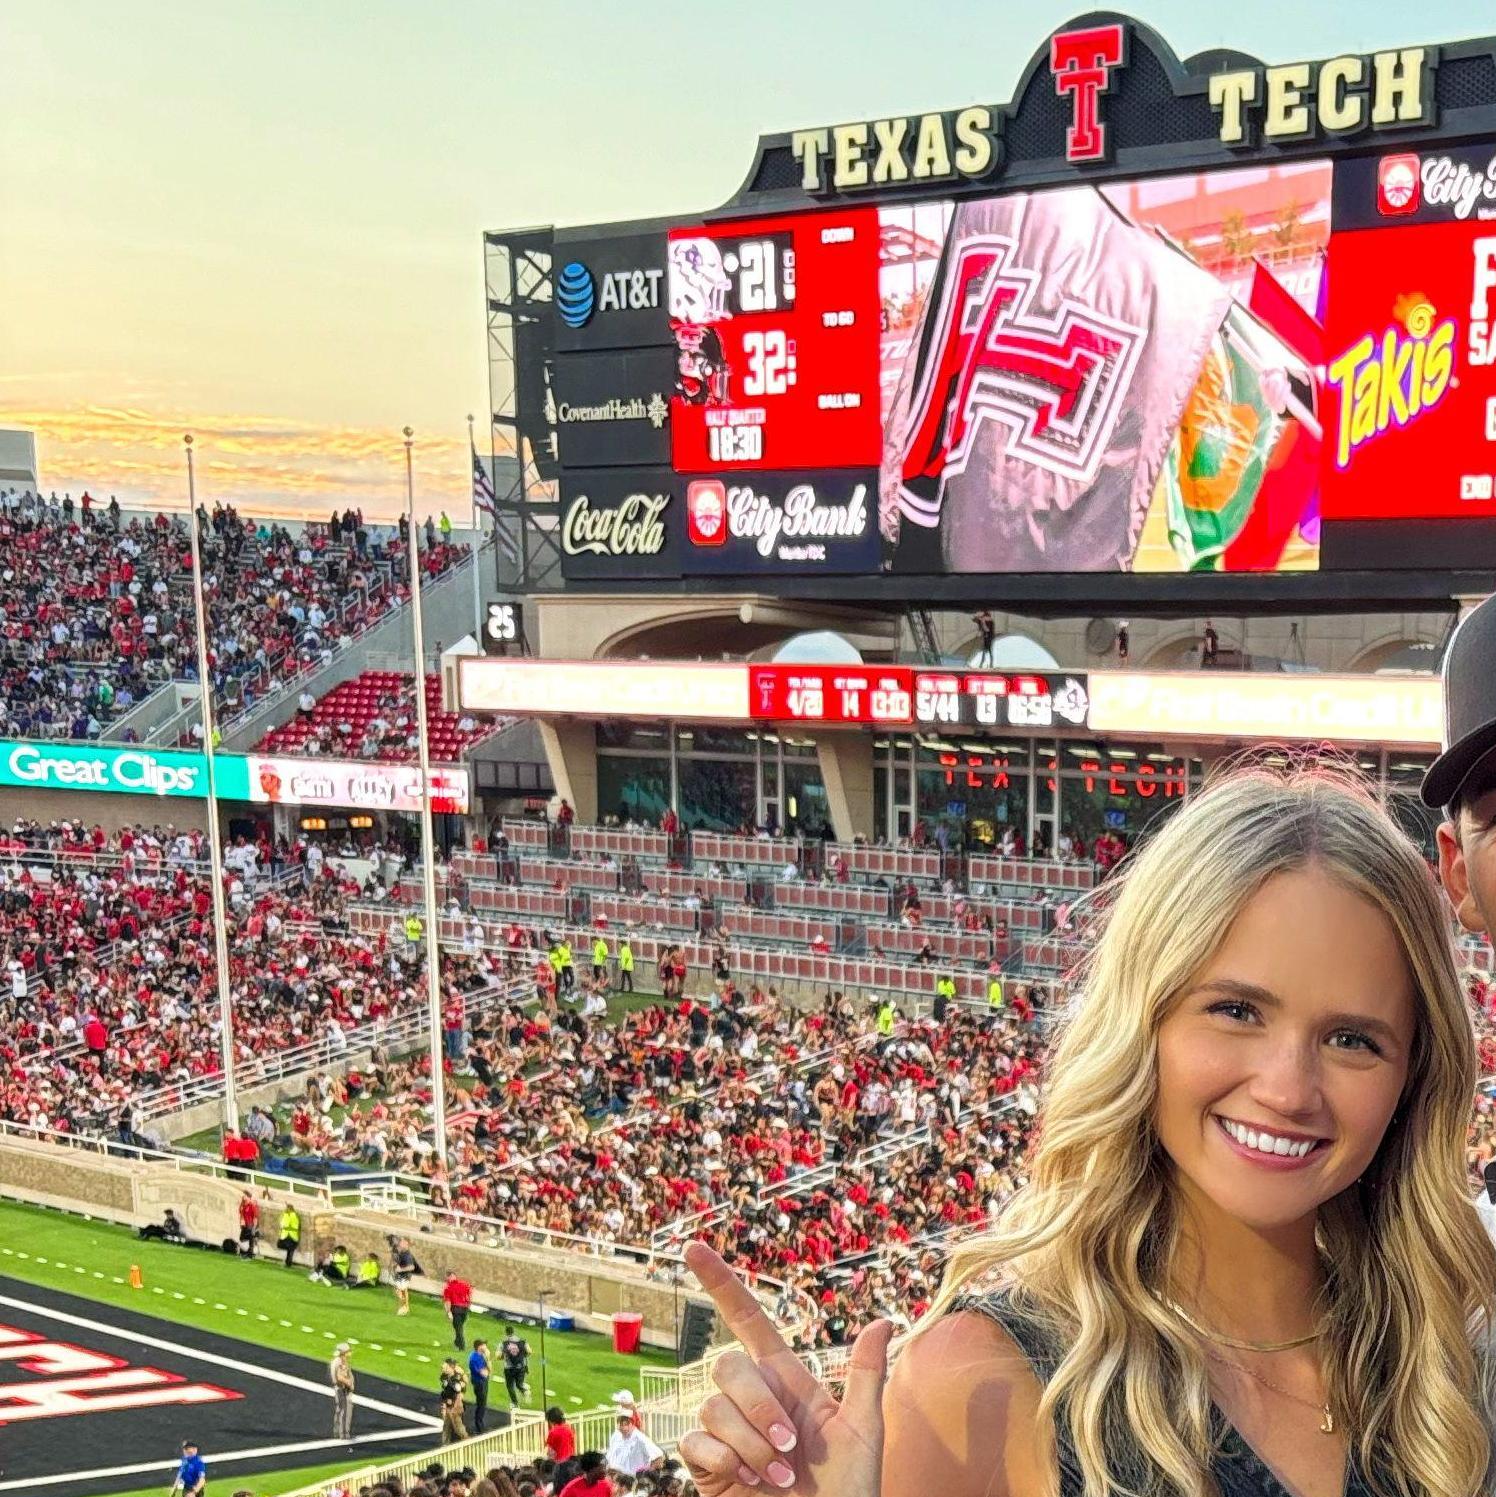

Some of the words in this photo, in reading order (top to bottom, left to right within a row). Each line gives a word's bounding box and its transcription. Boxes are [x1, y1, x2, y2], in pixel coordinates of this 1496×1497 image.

[791, 106, 994, 192] TEXAS
[1208, 48, 1426, 144] TECH
[1421, 156, 1483, 219] City
[600, 269, 663, 312] AT&T
[739, 241, 777, 311] 21
[744, 330, 787, 395] 32
[709, 426, 762, 461] 18:30
[1460, 474, 1492, 499] END
[727, 486, 783, 557] City
[783, 484, 867, 538] Bank
[488, 605, 515, 639] 25
[9, 744, 109, 787] Great
[112, 752, 193, 796] Clips
[939, 753, 1058, 792] TEXS
[1080, 762, 1185, 798] TECH
